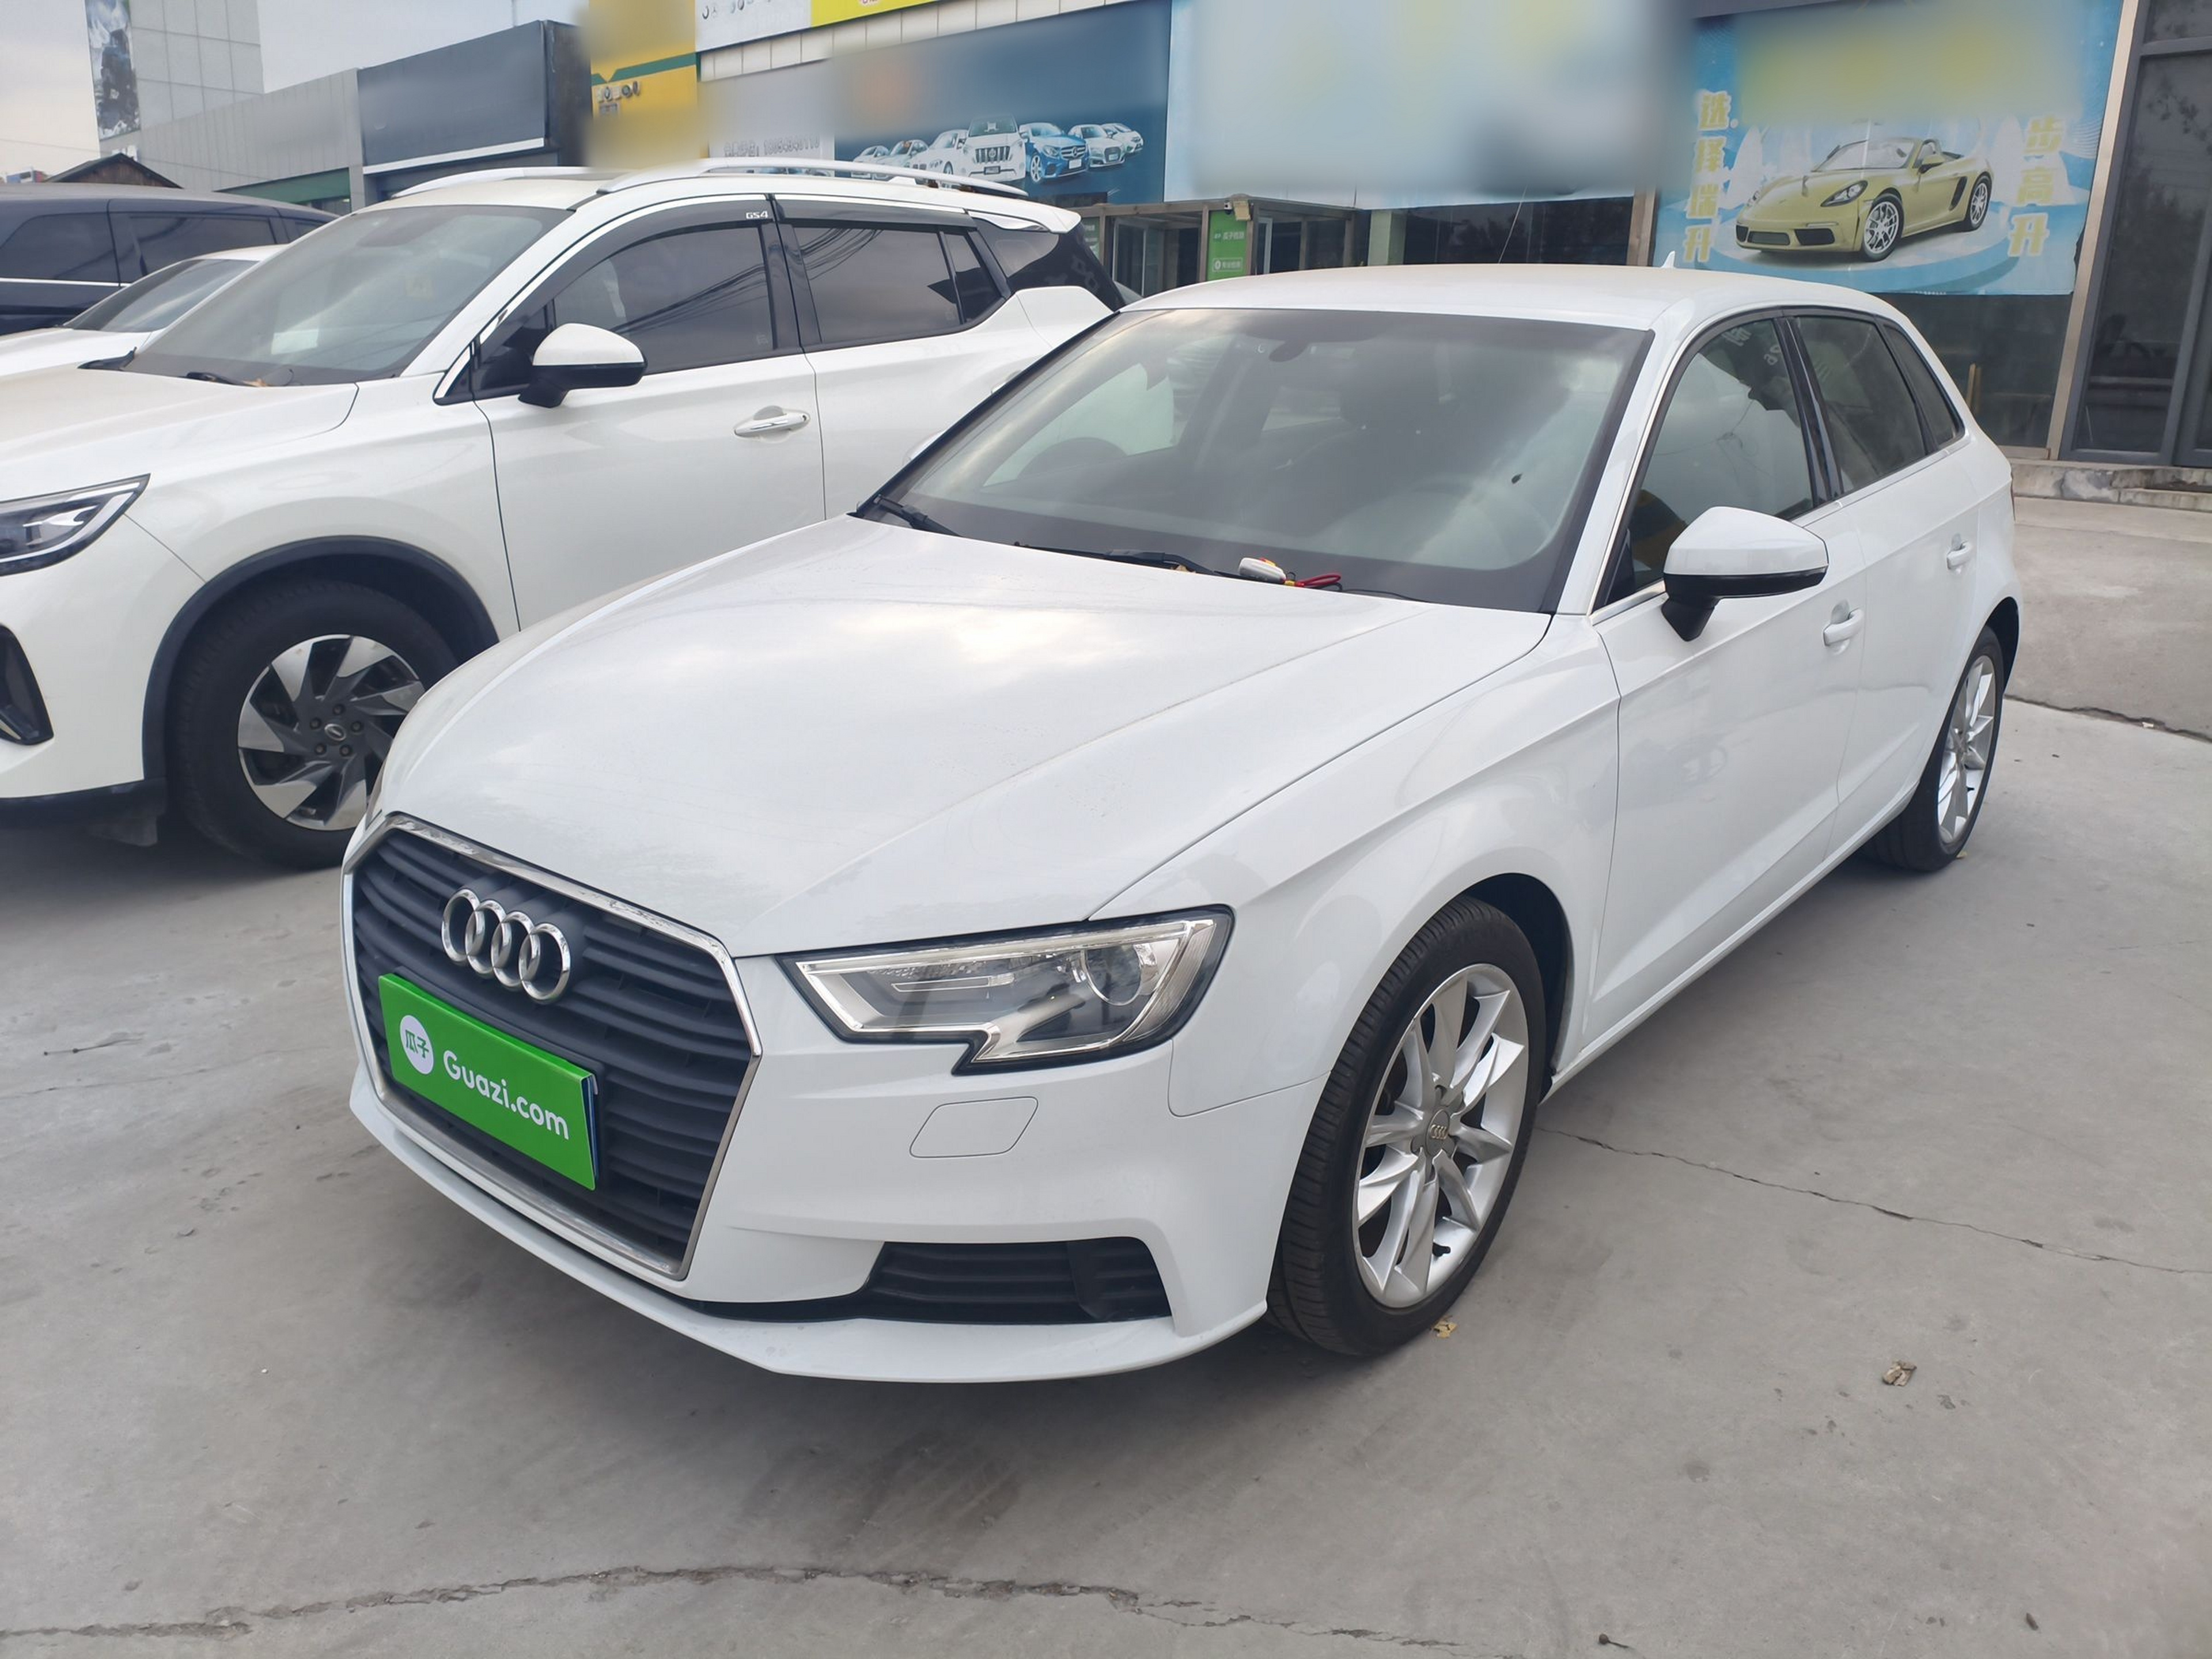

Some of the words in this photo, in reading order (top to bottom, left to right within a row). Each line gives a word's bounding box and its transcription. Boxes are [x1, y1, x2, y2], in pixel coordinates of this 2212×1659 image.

[746, 211, 768, 219] GS4
[404, 1028, 430, 1059] 瓜子
[443, 1050, 569, 1140] Guazi.com
